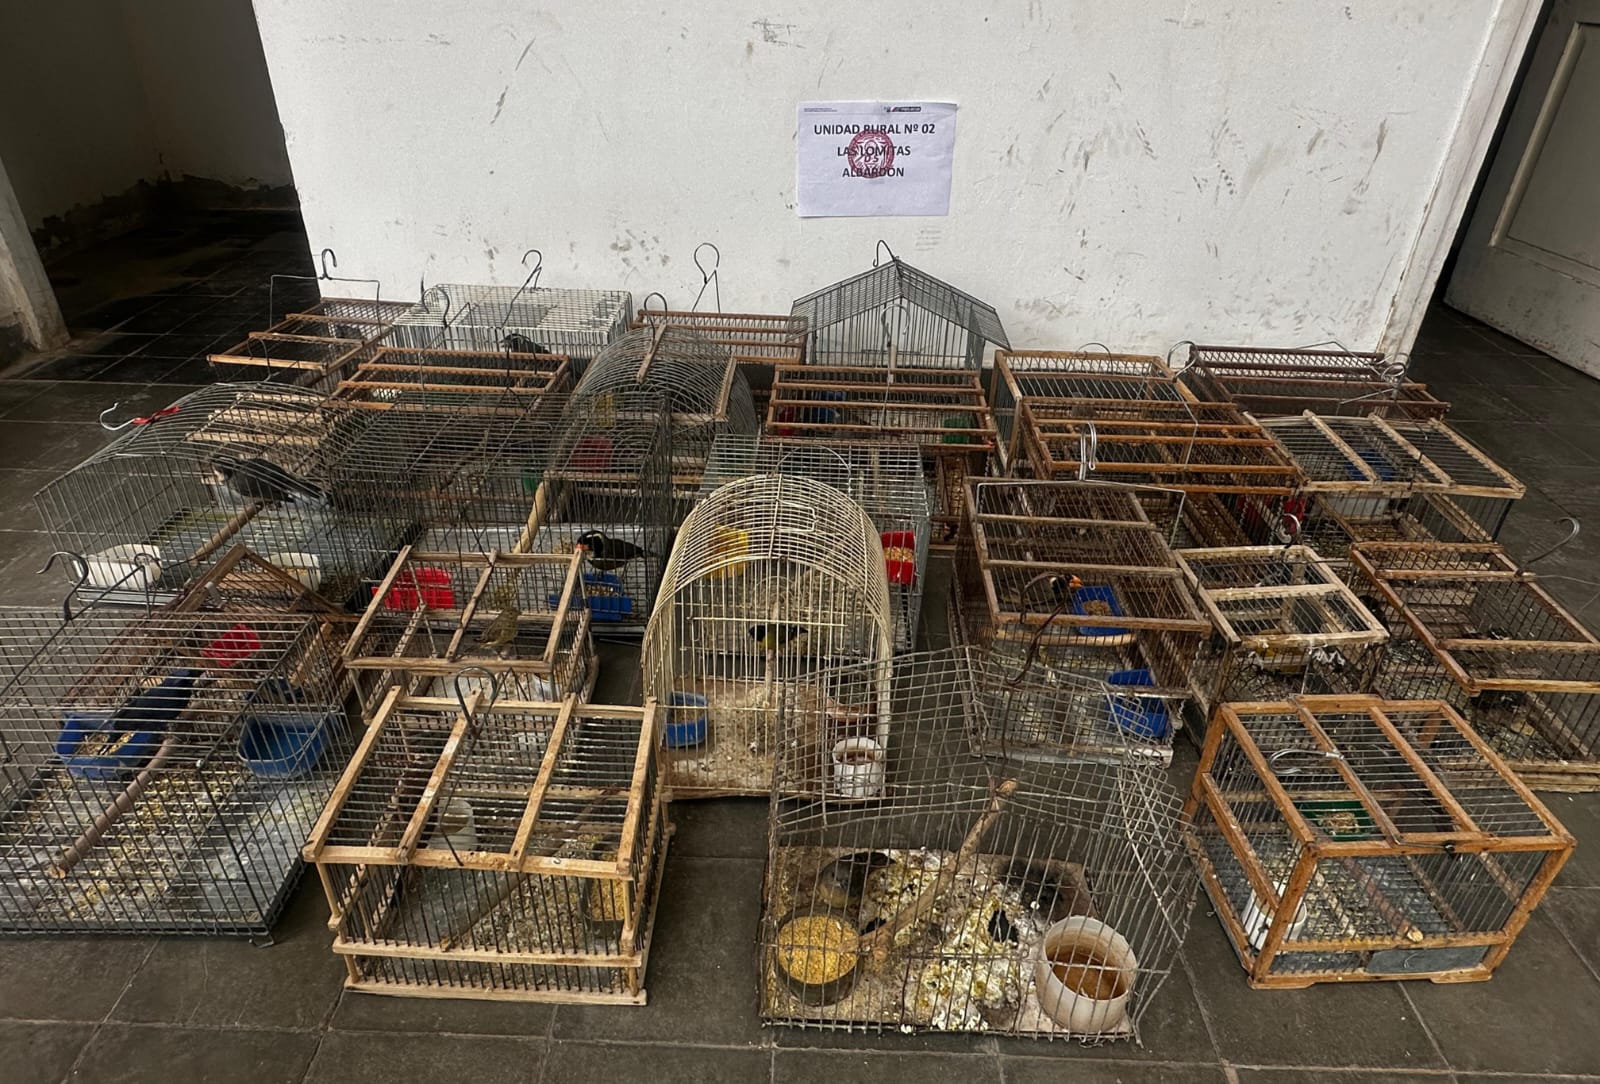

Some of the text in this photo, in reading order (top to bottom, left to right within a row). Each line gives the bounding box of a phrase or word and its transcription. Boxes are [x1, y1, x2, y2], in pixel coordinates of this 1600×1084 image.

[814, 124, 860, 135] UNIDAD
[863, 124, 902, 135] RURAL
[921, 123, 936, 134] 02
[837, 145, 911, 157] LAS LOMITAS
[842, 167, 904, 178] ALBARDON
